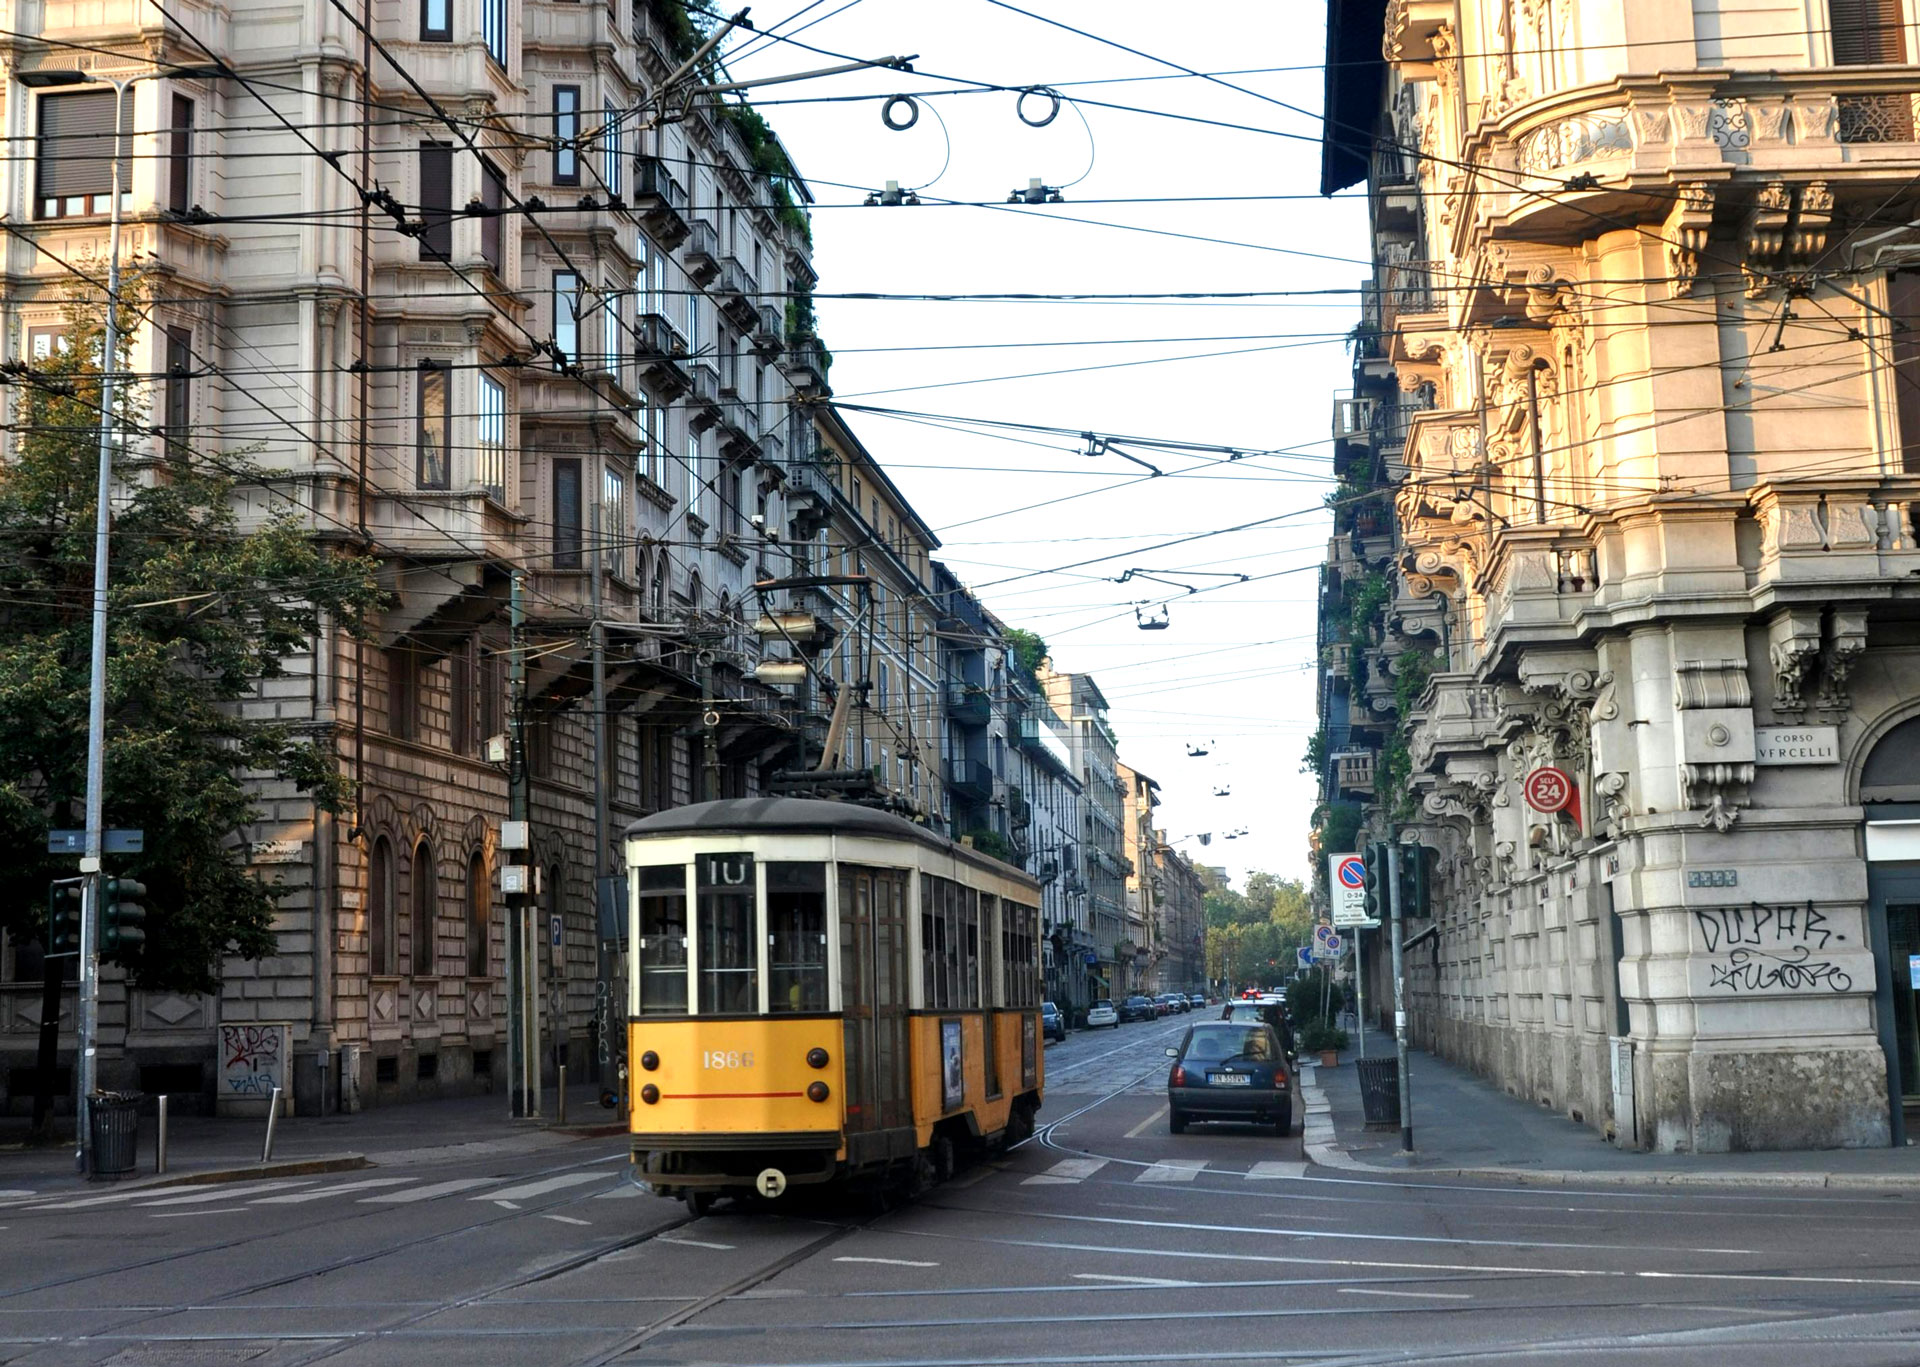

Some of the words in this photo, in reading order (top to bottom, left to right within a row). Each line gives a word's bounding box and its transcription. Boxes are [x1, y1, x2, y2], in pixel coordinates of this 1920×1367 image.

[1774, 734, 1813, 743] CORSO
[1539, 777, 1556, 785] SELF
[1537, 784, 1561, 799] 24
